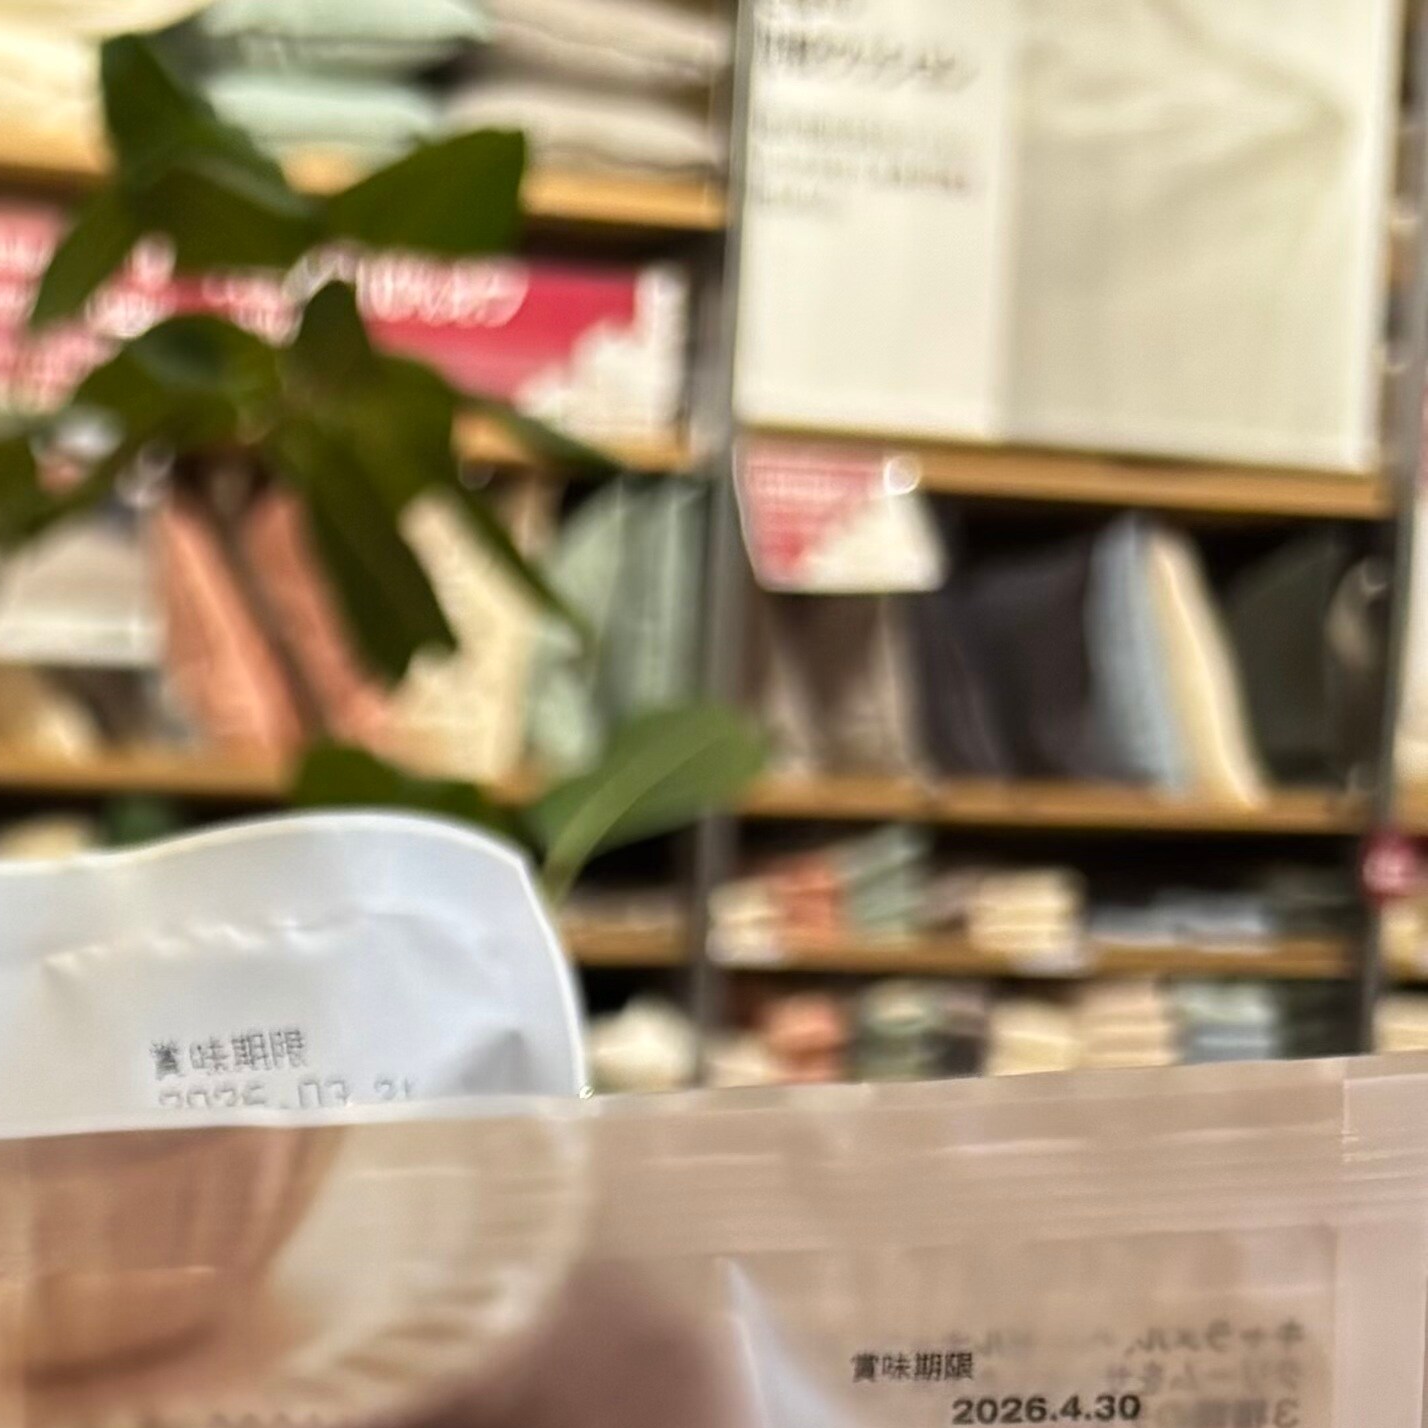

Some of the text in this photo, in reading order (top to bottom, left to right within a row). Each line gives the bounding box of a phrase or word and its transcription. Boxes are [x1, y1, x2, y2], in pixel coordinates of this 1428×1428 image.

[851, 1351, 975, 1383] 賞味期限
[951, 1394, 1141, 1426] 2026.4.30
